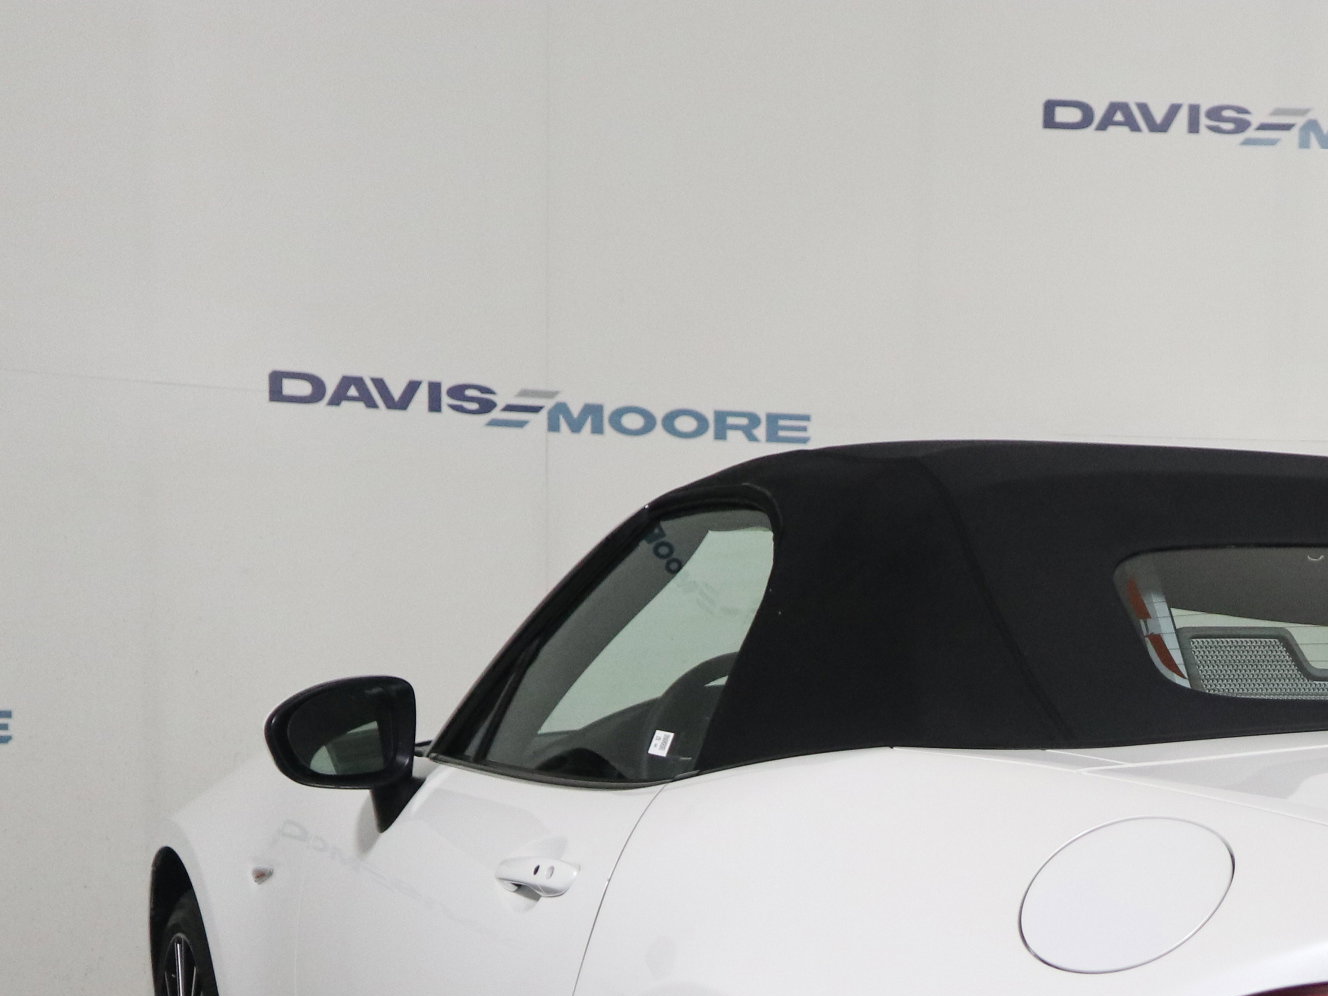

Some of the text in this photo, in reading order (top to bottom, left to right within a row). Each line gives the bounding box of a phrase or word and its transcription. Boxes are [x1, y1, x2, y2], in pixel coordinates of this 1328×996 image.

[1042, 98, 1252, 134] DAVIS
[268, 369, 811, 444] DAVIS MOORE
